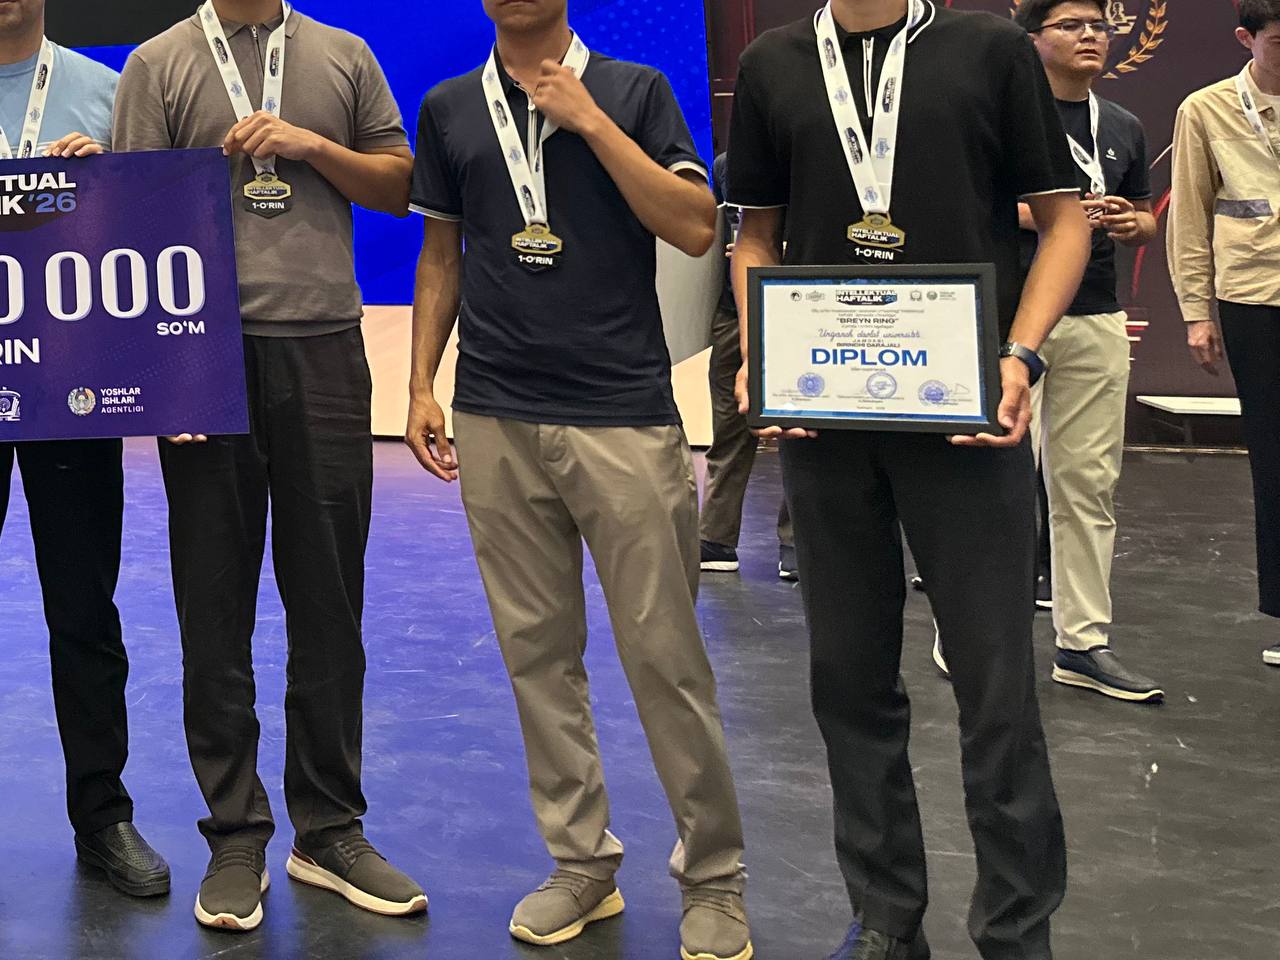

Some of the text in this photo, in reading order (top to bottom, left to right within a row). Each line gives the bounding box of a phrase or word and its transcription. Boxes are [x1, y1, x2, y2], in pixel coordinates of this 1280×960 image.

[28, 191, 77, 214] '26
[45, 245, 206, 322] 000
[811, 348, 927, 366] DIPLOM
[101, 387, 141, 396] YOSHLAR
[102, 396, 135, 405] ISHLARI
[101, 405, 144, 414] AGENTLIGI
